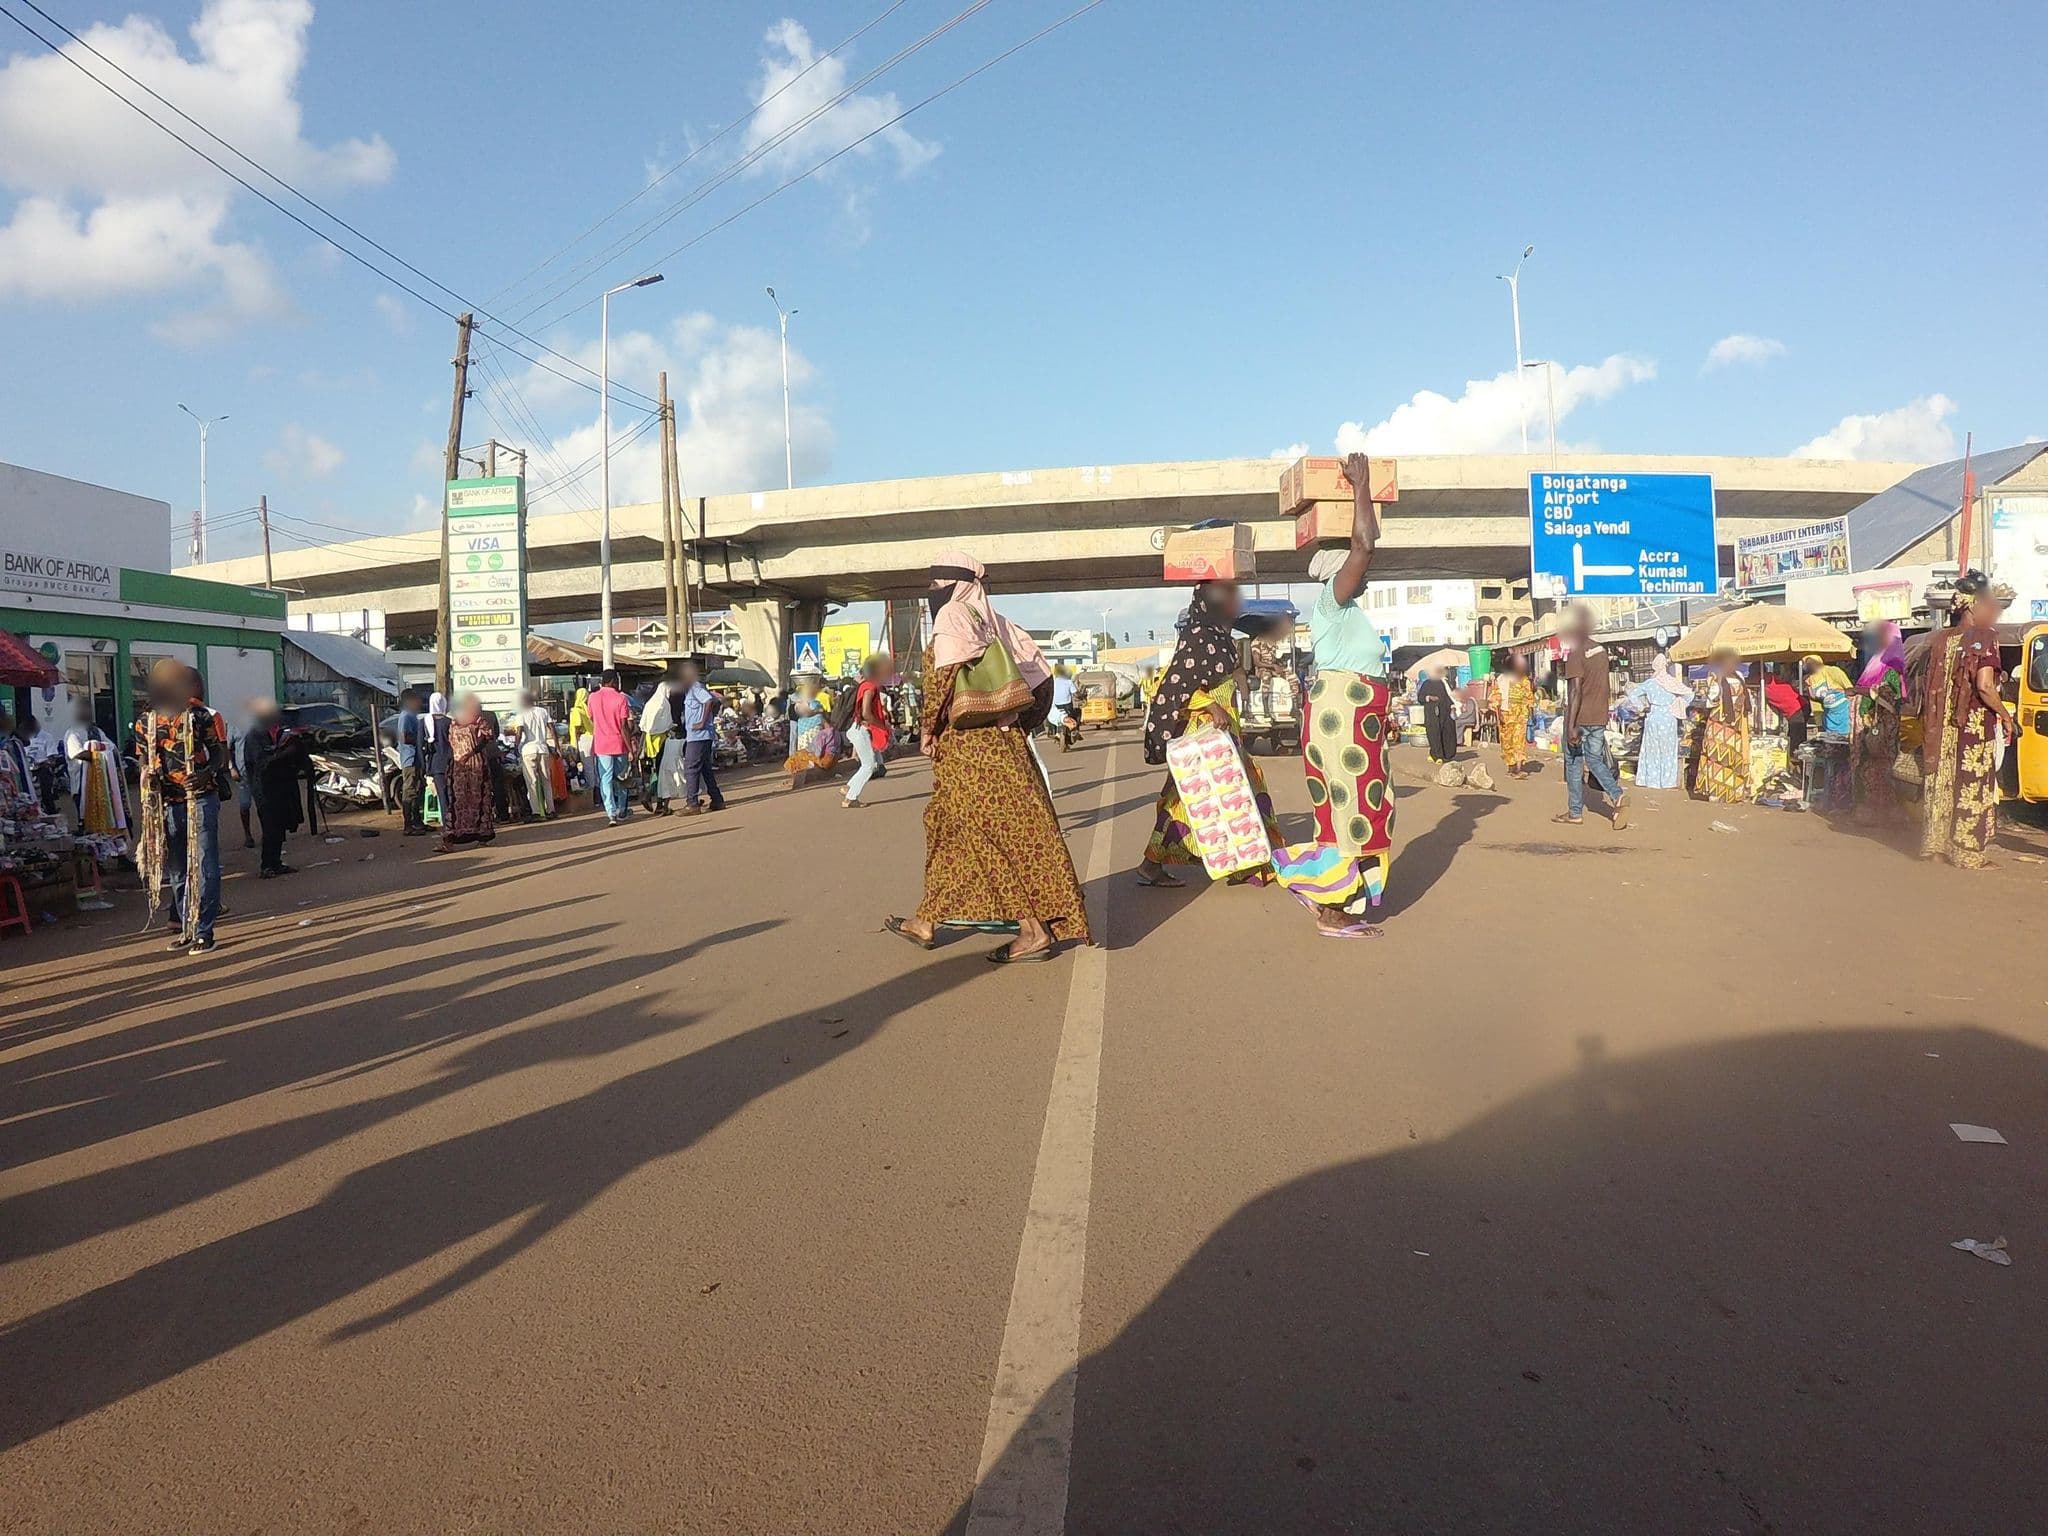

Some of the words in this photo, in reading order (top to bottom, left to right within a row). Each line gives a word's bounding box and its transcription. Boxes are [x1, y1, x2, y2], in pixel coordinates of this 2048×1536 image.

[1543, 475, 1627, 493] Bolgatanga
[1544, 491, 1600, 507] Airport
[1544, 506, 1573, 520] CBD
[1544, 521, 1591, 538] Salaga
[1594, 520, 1630, 535] Yendi
[1770, 530, 1797, 543] BEAUTY
[1798, 521, 1844, 538] ENTERPRISE
[467, 537, 500, 550] VISA
[1639, 550, 1680, 563] Accra
[4, 553, 43, 575] BANK
[46, 559, 64, 577] OF
[66, 562, 111, 584] AFRICA
[1639, 565, 1687, 578] Kumasi
[4, 576, 39, 588] Groupe
[43, 580, 69, 592] BMCE
[72, 584, 96, 594] BANK
[1641, 579, 1704, 593] Techiman
[459, 673, 516, 687] BOAweb
